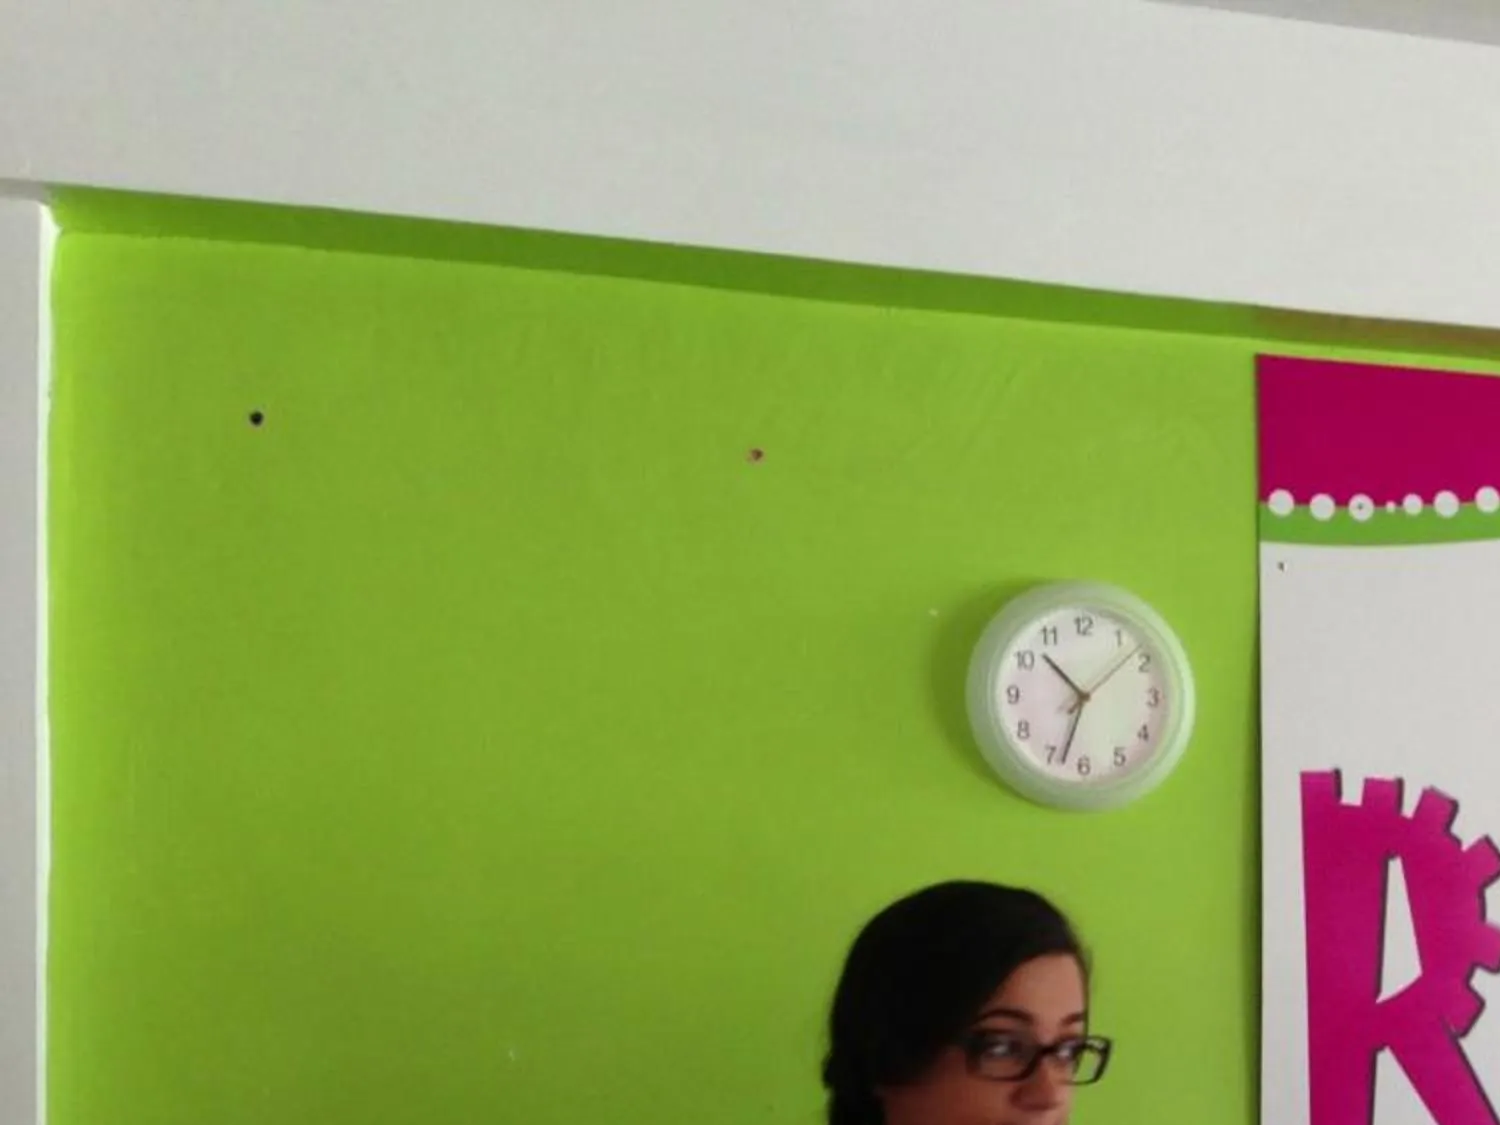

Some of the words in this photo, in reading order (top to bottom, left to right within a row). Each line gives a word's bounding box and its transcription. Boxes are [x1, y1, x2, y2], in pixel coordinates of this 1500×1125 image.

[1074, 616, 1094, 636] 12
[1041, 626, 1058, 646] 11
[1016, 650, 1035, 671] 10
[1138, 653, 1151, 673] 2
[1007, 685, 1020, 704] 9
[1147, 688, 1159, 708] 3
[1017, 720, 1030, 739] 8
[1138, 724, 1149, 741] 4
[1045, 746, 1057, 764] 7
[1113, 747, 1126, 766] 5
[1077, 756, 1091, 775] 6
